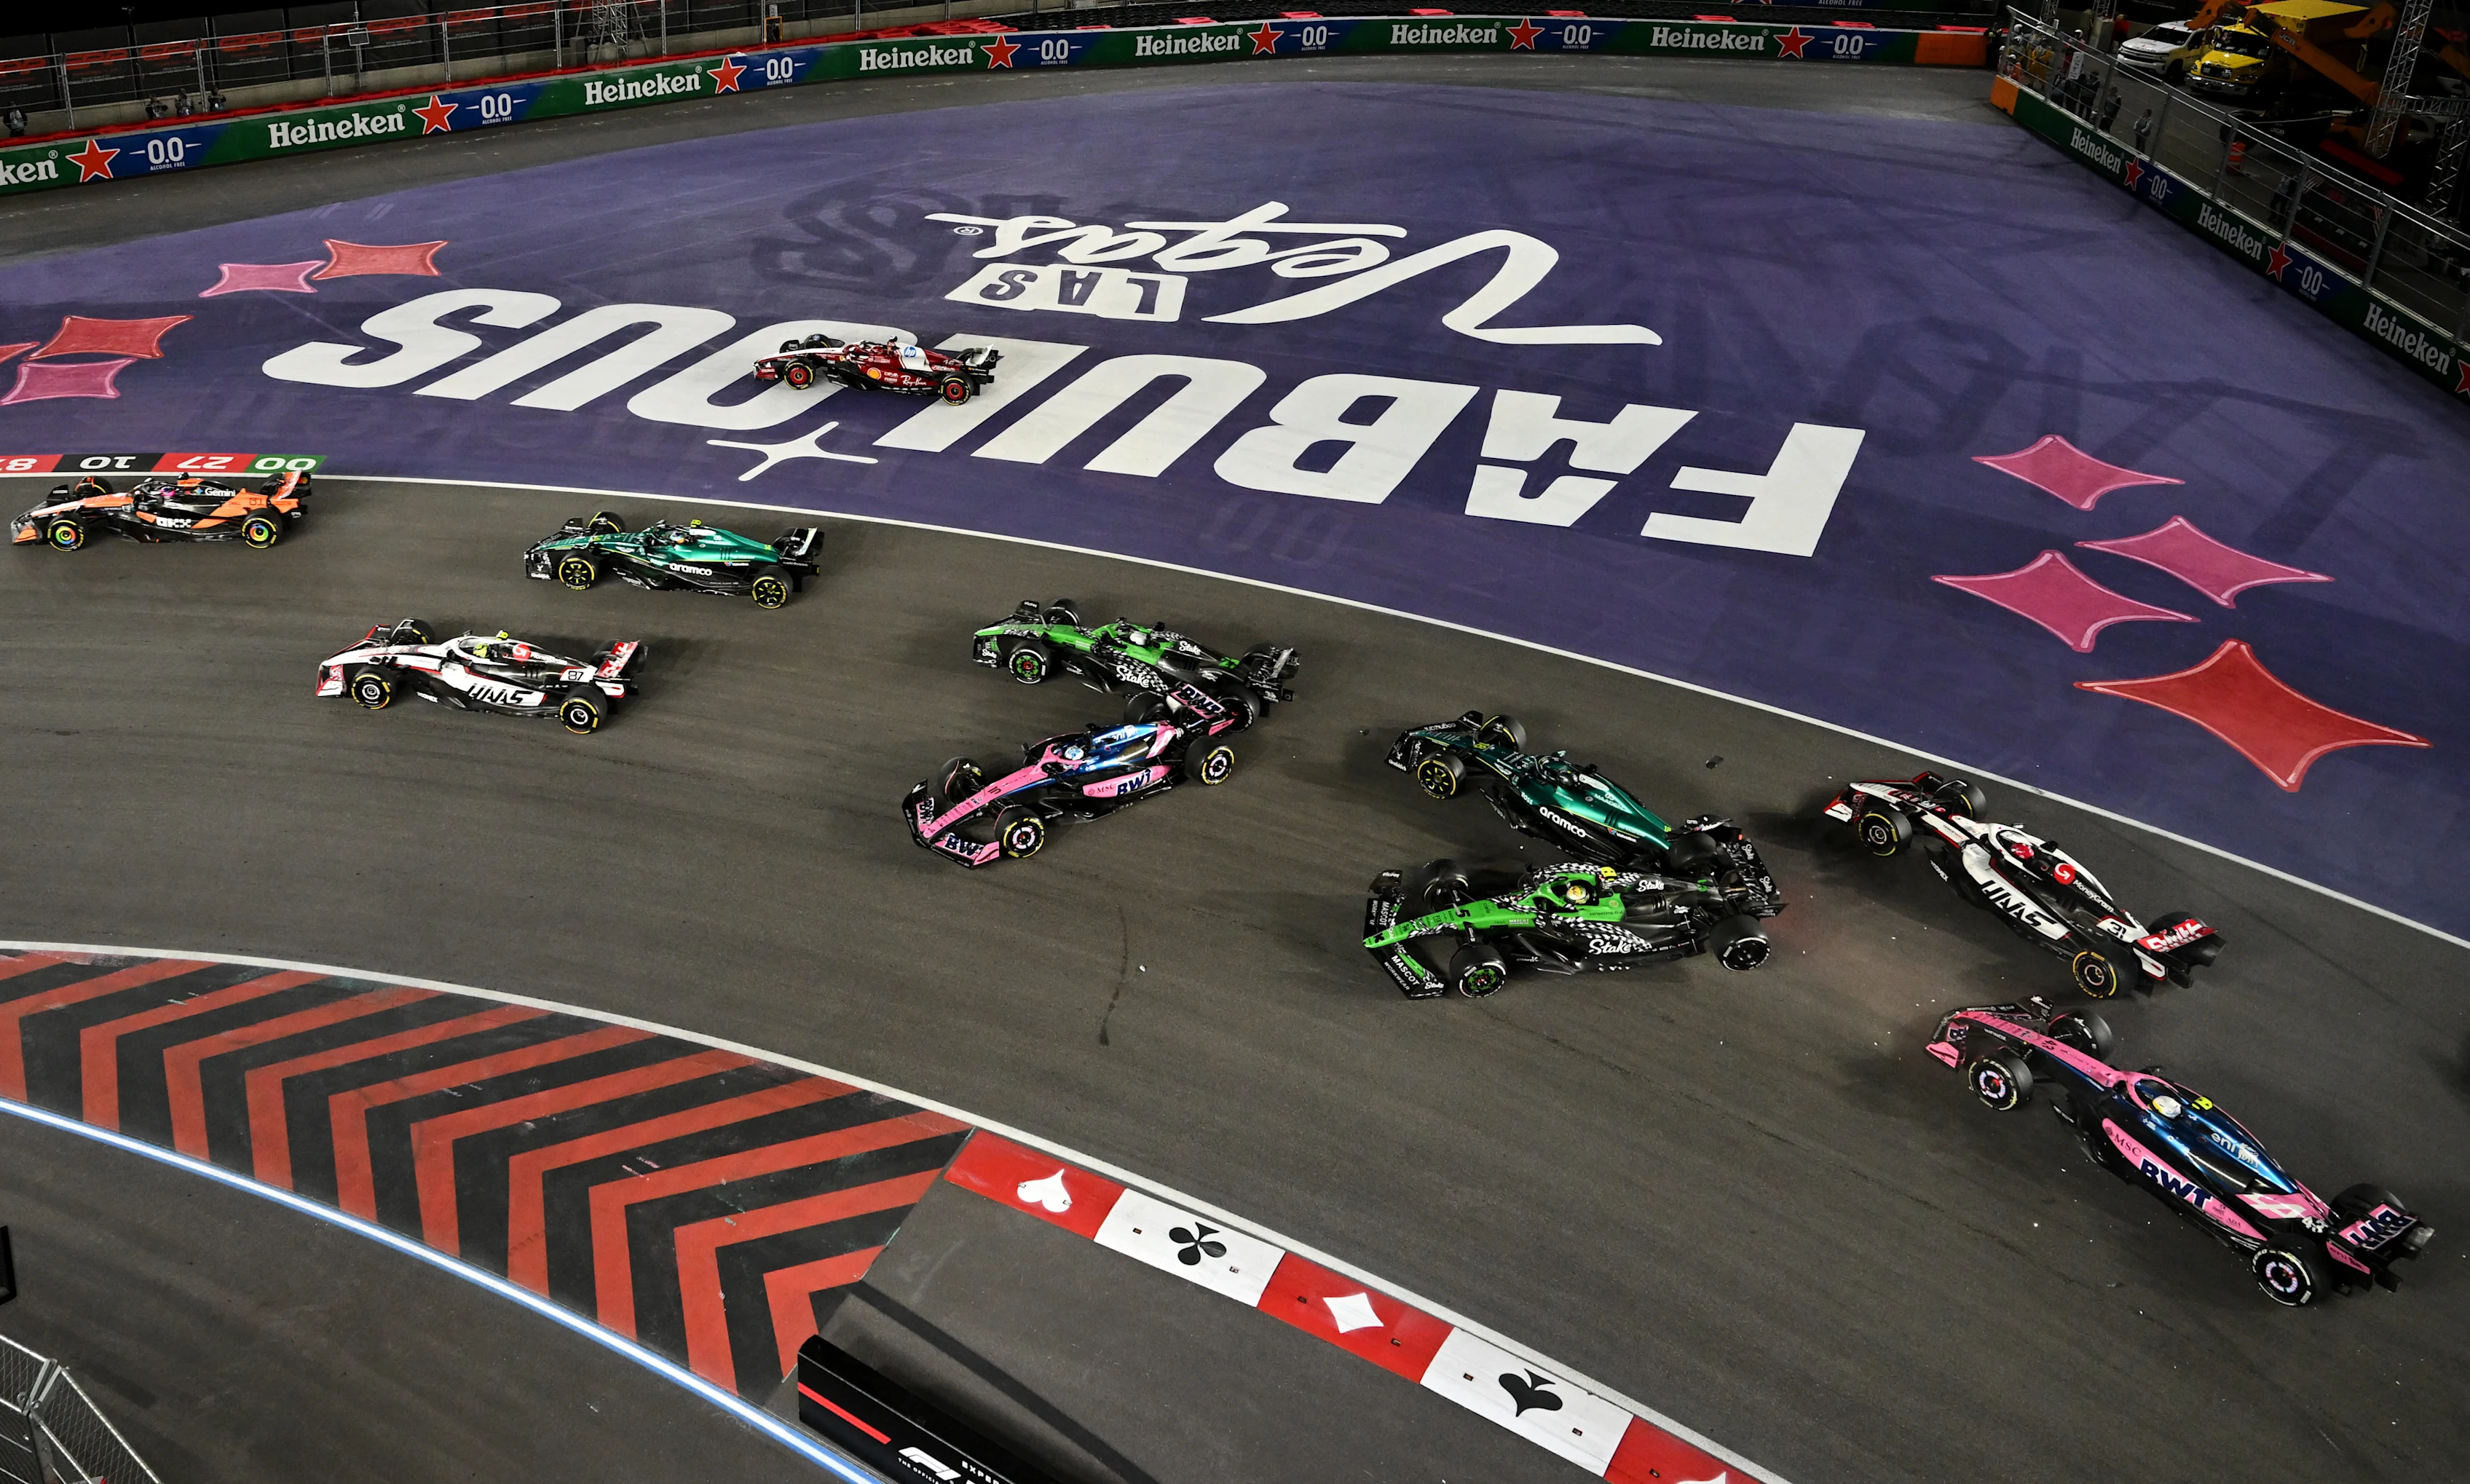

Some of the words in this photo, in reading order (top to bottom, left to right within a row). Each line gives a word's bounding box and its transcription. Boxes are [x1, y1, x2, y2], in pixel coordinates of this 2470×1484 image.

[2278, 32, 2297, 47] JCB
[482, 117, 502, 125] ALCOHOL
[269, 112, 405, 149] Heineken
[150, 162, 173, 171] ALCOHOL
[175, 161, 185, 169] FREE
[901, 375, 927, 387] Ray-Ban
[263, 288, 1866, 558] FABULOUS
[0, 457, 38, 472] 8
[79, 456, 137, 470] 10
[177, 456, 234, 470] 27
[205, 487, 236, 497] Gemini
[669, 563, 713, 577] aramco
[1179, 641, 1202, 656] Stake
[568, 671, 584, 681] 87
[1116, 666, 1150, 688] Stake
[468, 683, 533, 705] HAAS
[1116, 769, 1152, 797] BWT
[1539, 807, 1586, 838] aramco
[1741, 843, 1754, 861] Stake
[1636, 880, 1665, 892] Stake
[1759, 876, 1772, 893] Stake
[1981, 880, 2059, 927] HAAS
[2073, 880, 2114, 913] MoneyGram
[2107, 921, 2128, 939] 31
[1588, 939, 1632, 955] Stake
[1384, 961, 1410, 991] WORKWEAR
[1391, 955, 1420, 986] MASCOT
[1424, 982, 1445, 990] Stake
[2114, 1134, 2142, 1157] MSC
[2211, 1132, 2238, 1153] eni
[2140, 1158, 2212, 1210] BWT
